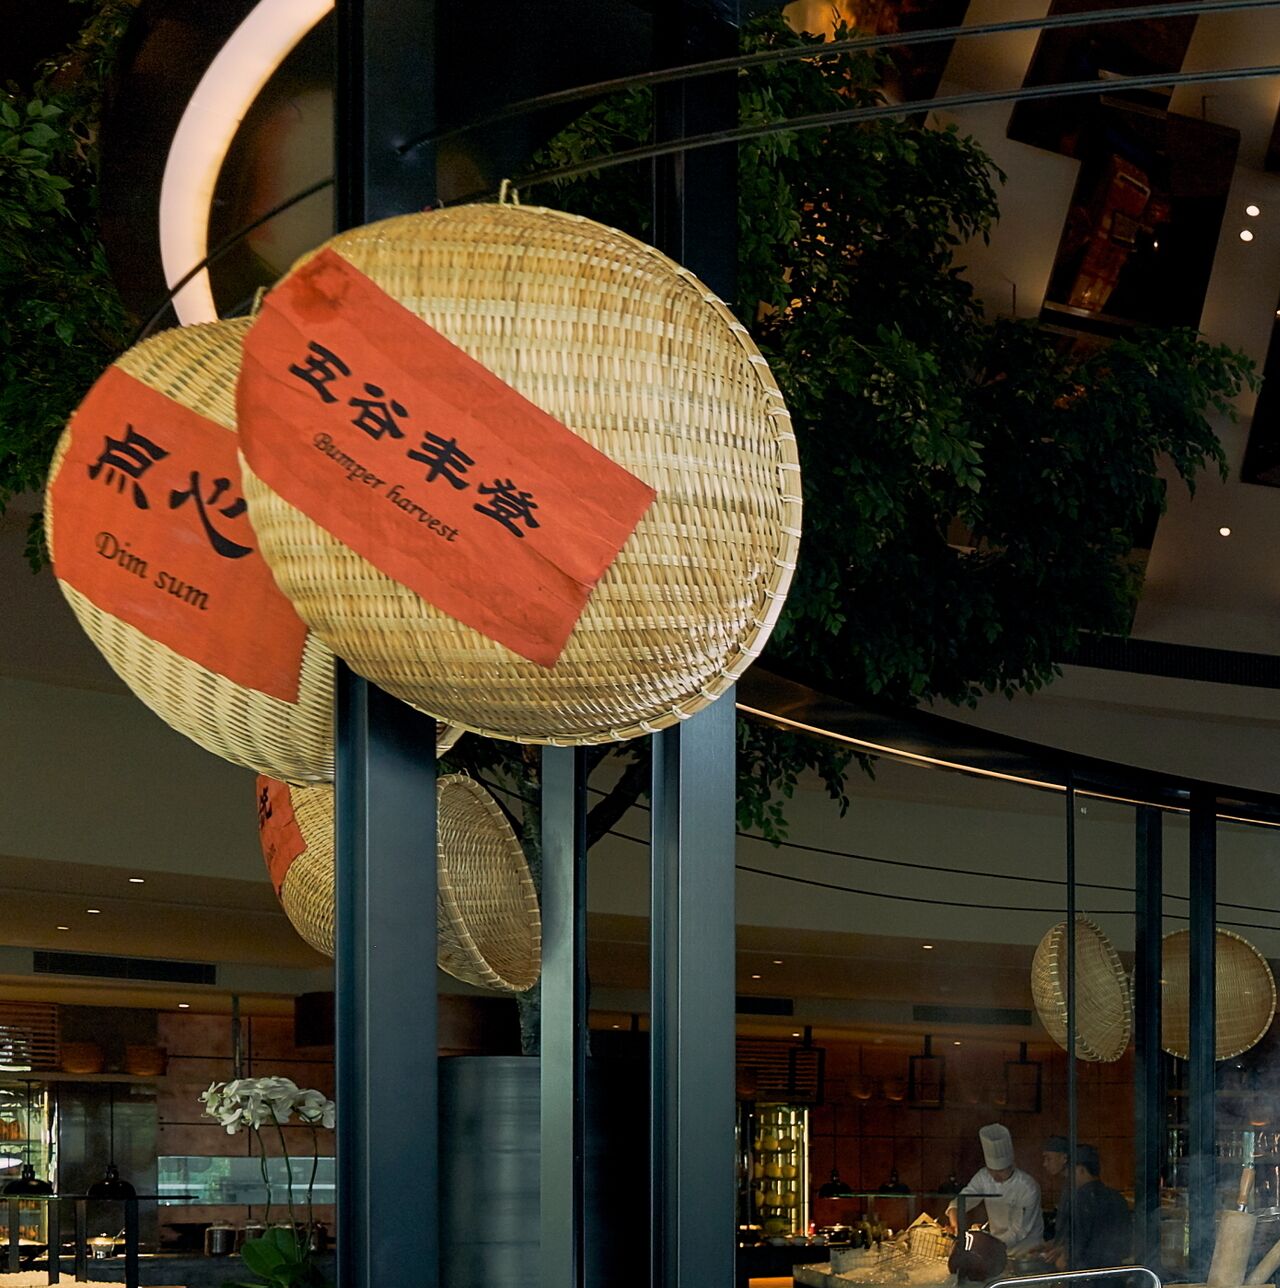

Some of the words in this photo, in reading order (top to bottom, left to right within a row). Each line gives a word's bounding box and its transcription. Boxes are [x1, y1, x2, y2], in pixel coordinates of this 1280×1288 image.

[86, 423, 255, 560] 点心
[288, 340, 541, 539] 五谷丰登
[312, 432, 387, 489] Bumper
[385, 485, 461, 543] harvest
[95, 531, 149, 580] Dim
[155, 570, 210, 613] sum
